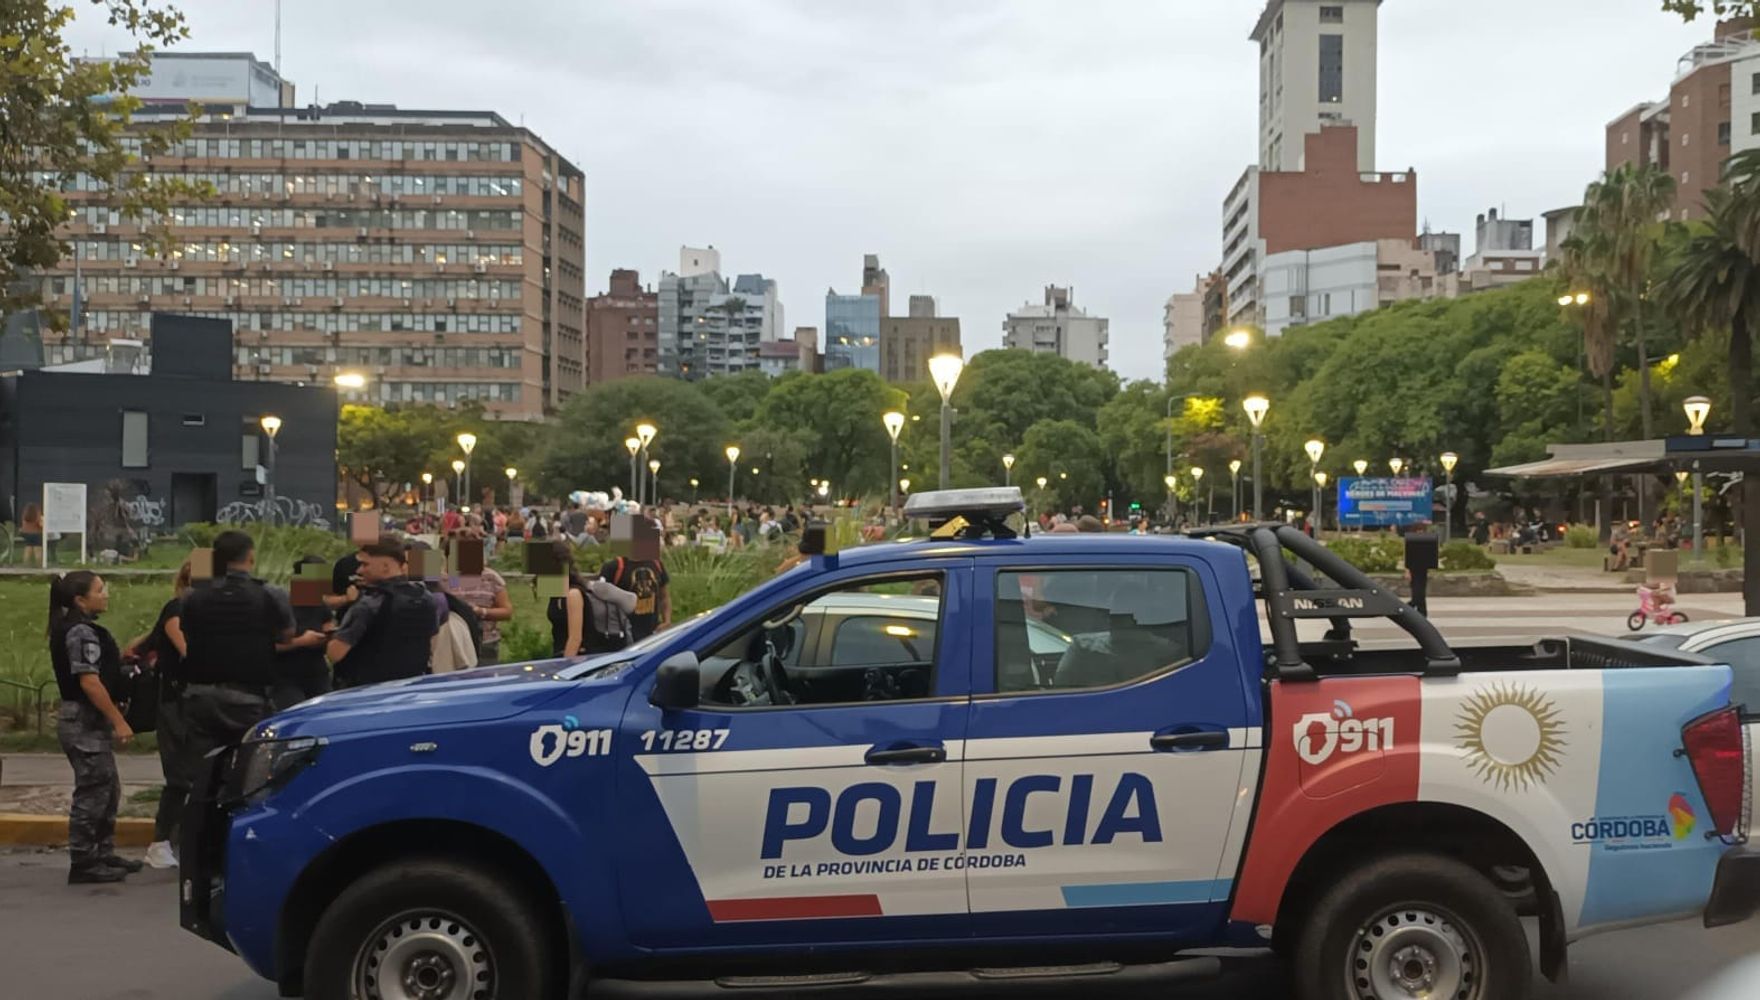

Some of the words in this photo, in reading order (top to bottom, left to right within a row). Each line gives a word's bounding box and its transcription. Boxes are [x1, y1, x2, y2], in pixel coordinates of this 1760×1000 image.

[566, 729, 613, 757] 911
[640, 729, 730, 750] 11287
[1340, 717, 1394, 752] 911
[760, 772, 1163, 860] POLICIA
[1571, 817, 1671, 840] CÓRDOBA
[763, 865, 786, 878] DE
[791, 864, 812, 877] LA
[816, 859, 912, 876] PROVINCIA
[917, 857, 939, 871] DE
[944, 852, 1026, 870] CÓRDOBA
